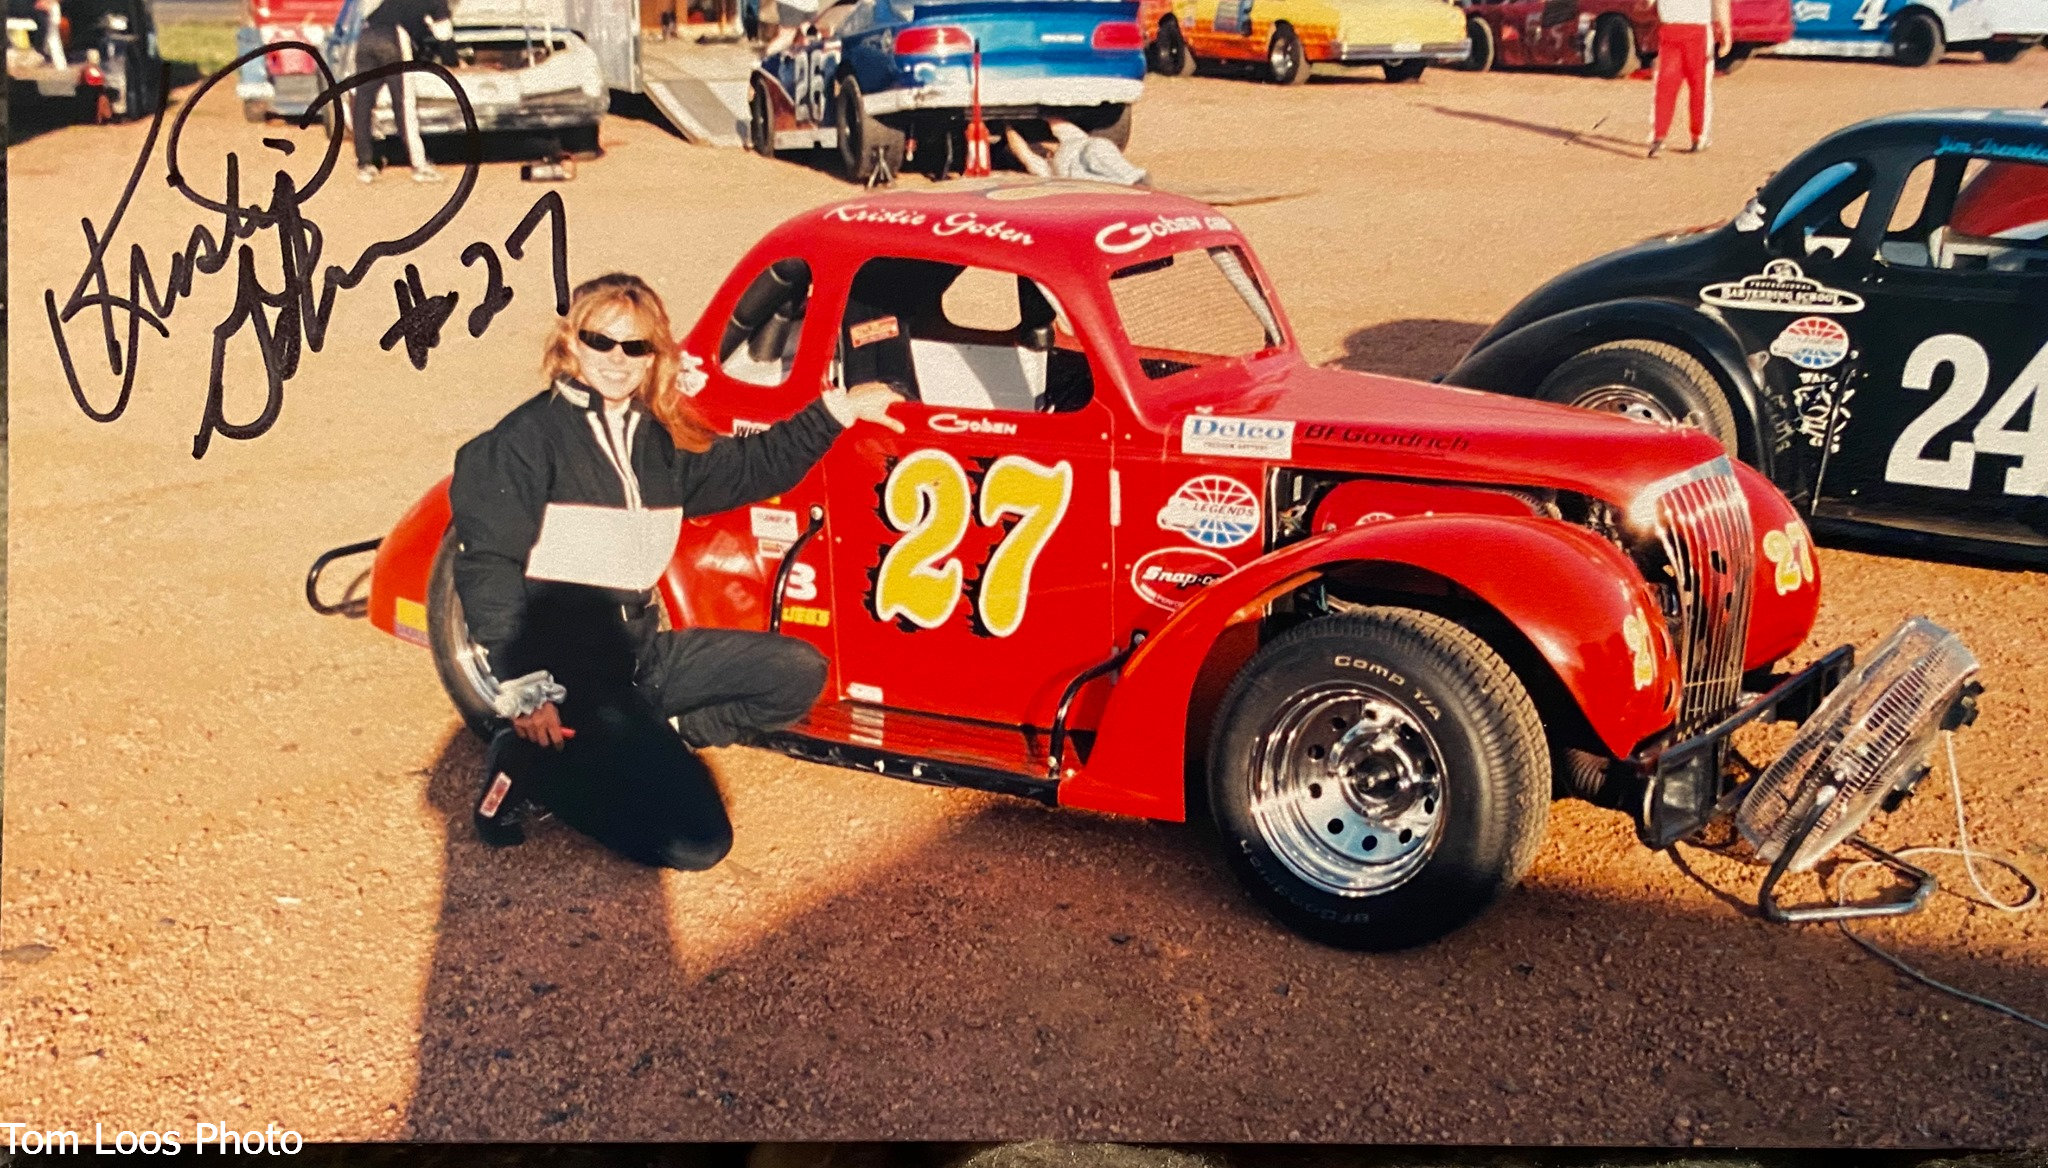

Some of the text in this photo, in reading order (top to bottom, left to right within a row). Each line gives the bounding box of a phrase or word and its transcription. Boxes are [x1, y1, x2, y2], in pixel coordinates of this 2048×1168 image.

[1852, 0, 1889, 31] 4
[823, 204, 1034, 246] Kristie Goben
[1193, 419, 1285, 440] Delco
[1884, 333, 2048, 497] 24
[1193, 502, 1255, 517] LEGENDS
[875, 448, 1074, 638] 27
[1762, 520, 1815, 596] 27
[1334, 655, 1406, 686] Comp
